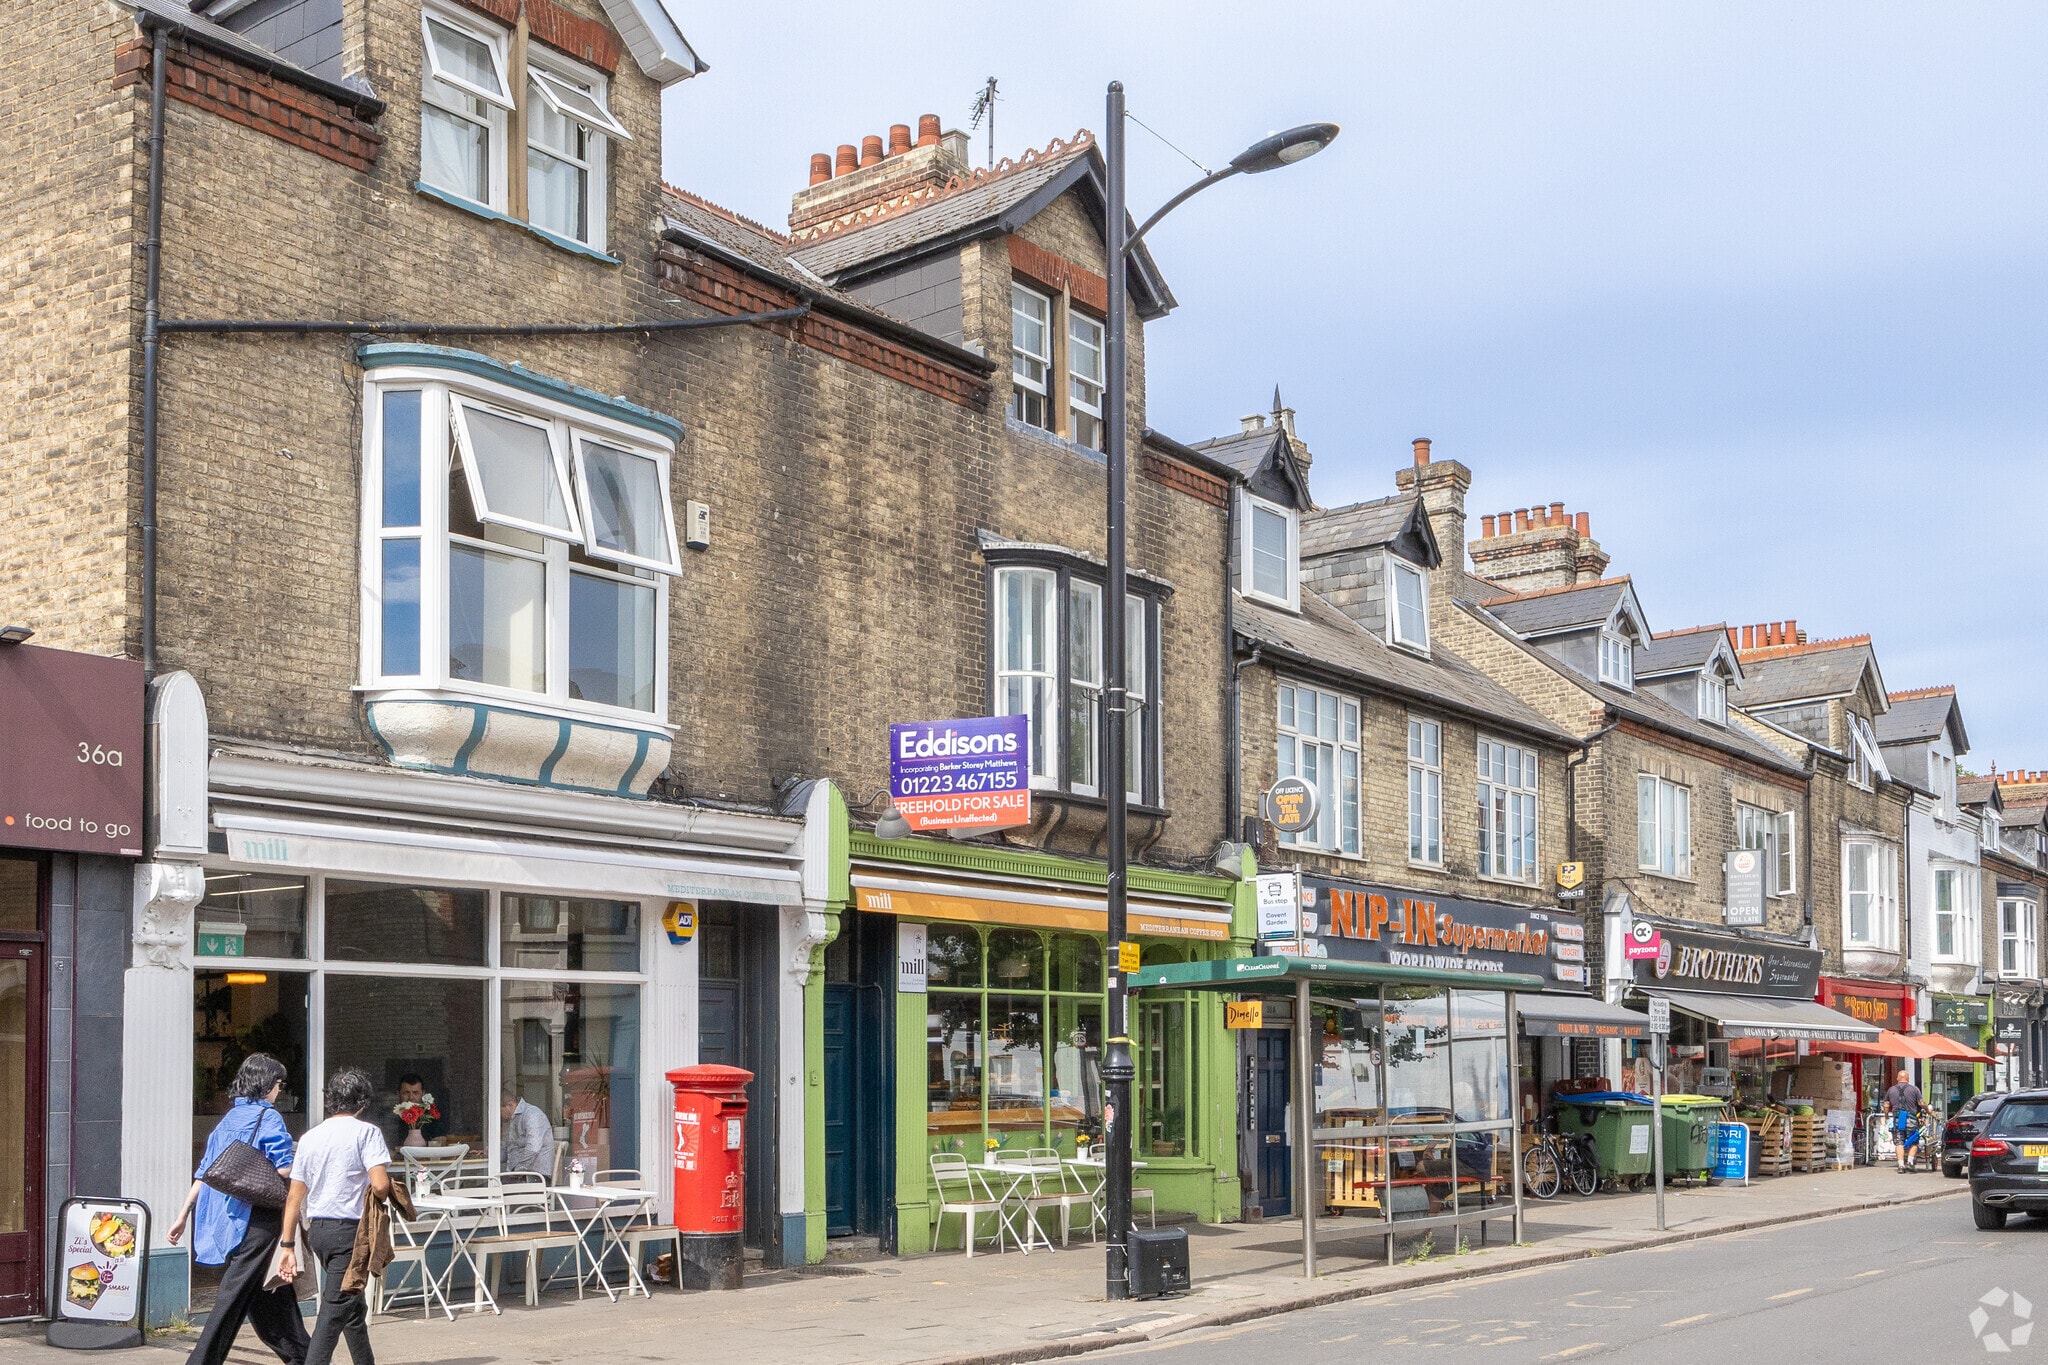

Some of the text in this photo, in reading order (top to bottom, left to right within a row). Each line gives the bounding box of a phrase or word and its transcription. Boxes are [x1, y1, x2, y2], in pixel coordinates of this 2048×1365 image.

[900, 729, 1018, 758] Eddisons
[77, 741, 123, 767] 36a
[900, 759, 1017, 774] Incorporating Barker Storey Matthews
[901, 771, 1017, 794] 01223 467155
[1285, 786, 1304, 794] LICENCE
[894, 794, 1025, 814] FREEHOLD FOR SALE
[1276, 794, 1304, 805] OPEN
[1281, 804, 1299, 814] TILL
[920, 812, 998, 826] (Business Unaffected)
[1279, 813, 1300, 824] LATE
[25, 813, 131, 839] food to go
[243, 836, 289, 861] mill
[866, 892, 893, 910] mill
[1329, 888, 1437, 947] NIP-IN
[1730, 906, 1759, 916] OPEN
[678, 914, 693, 926] ADT
[1140, 923, 1188, 935] MEDITERRANEAN
[1189, 927, 1210, 937] COFFEE
[1441, 914, 1549, 956] Supermarket
[1558, 926, 1569, 935] FRUIT
[1561, 947, 1579, 956] GROCERY
[1628, 946, 1658, 956] payzone
[901, 958, 924, 975] mill
[1679, 946, 1765, 985] BROTHERS
[1562, 969, 1577, 978] BAKERY
[1229, 1006, 1259, 1023] Dimello
[1558, 1023, 1573, 1033] FRUIT
[1580, 1024, 1590, 1034] VEG
[1595, 1025, 1619, 1035] ORGANIC
[68, 1244, 92, 1254] Special
